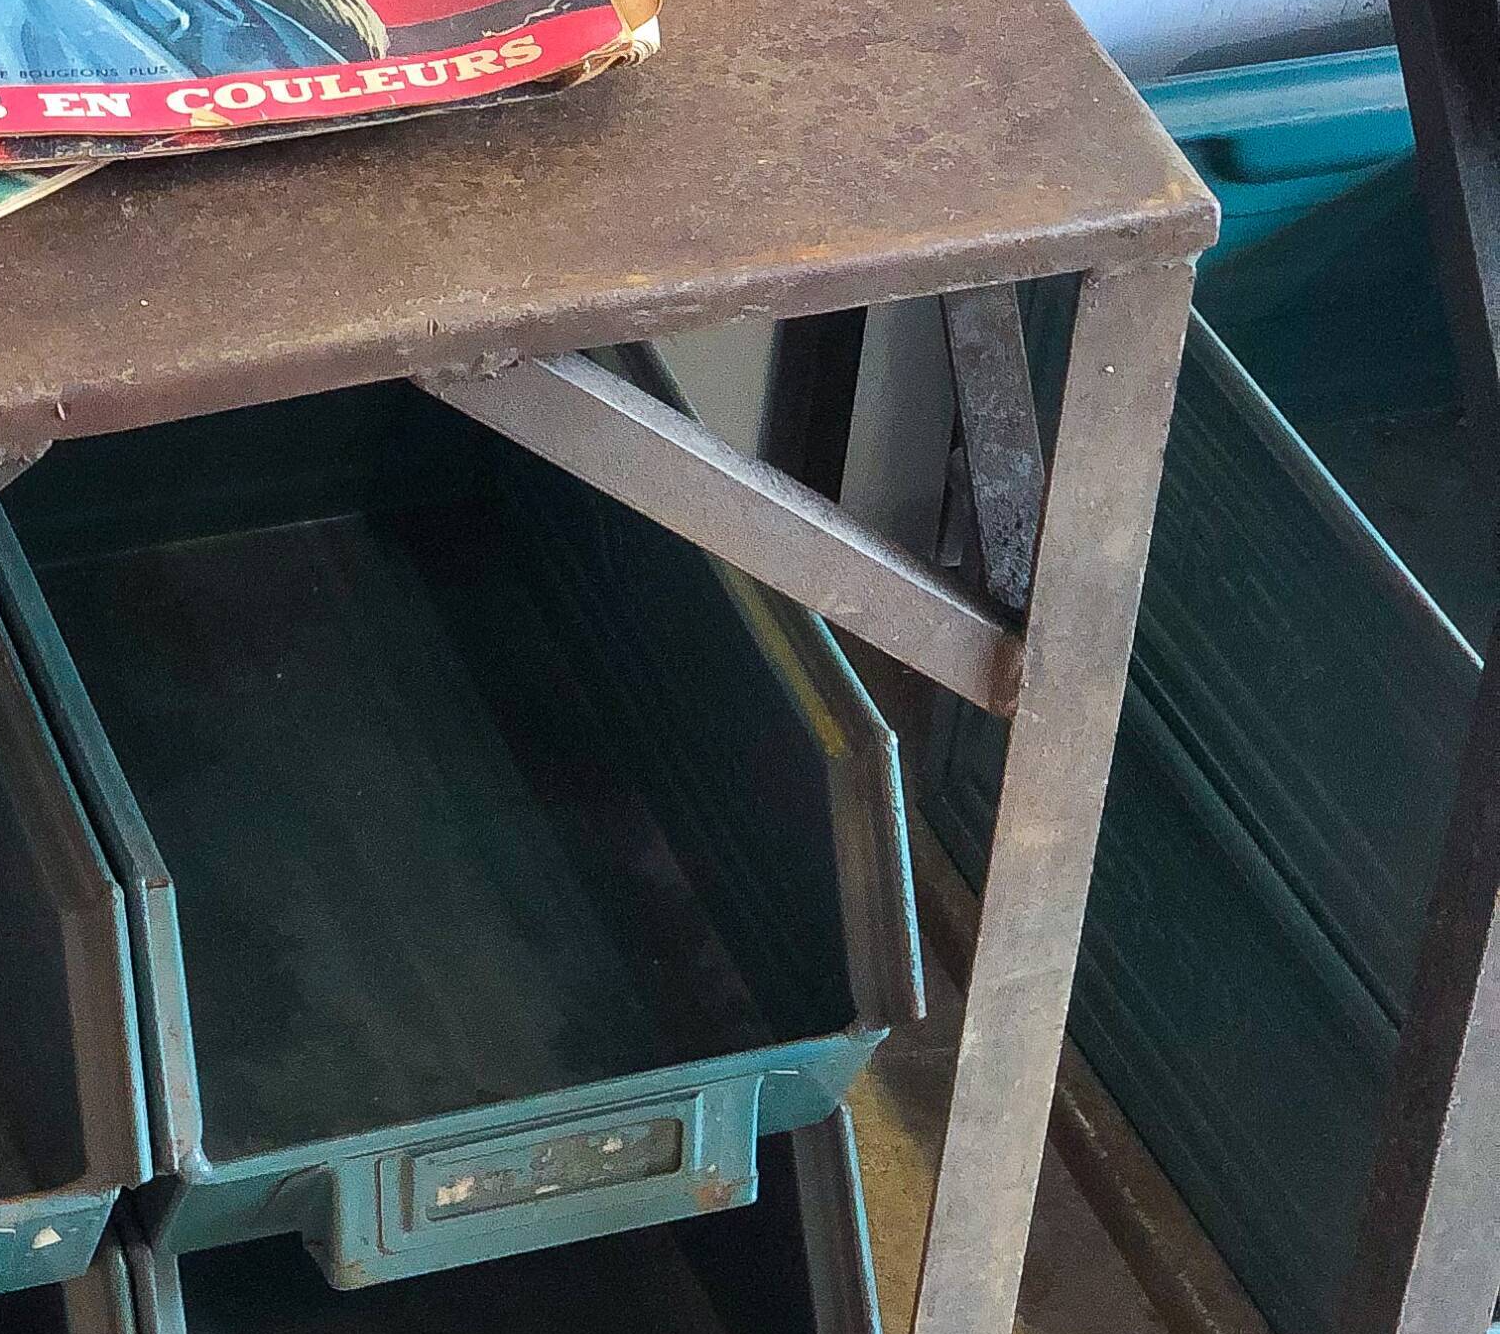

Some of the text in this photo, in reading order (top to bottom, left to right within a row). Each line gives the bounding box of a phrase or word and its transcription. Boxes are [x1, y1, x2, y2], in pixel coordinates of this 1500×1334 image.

[19, 68, 119, 79] BOUGEONS
[37, 92, 133, 118] EN
[165, 34, 544, 115] COULEURS
